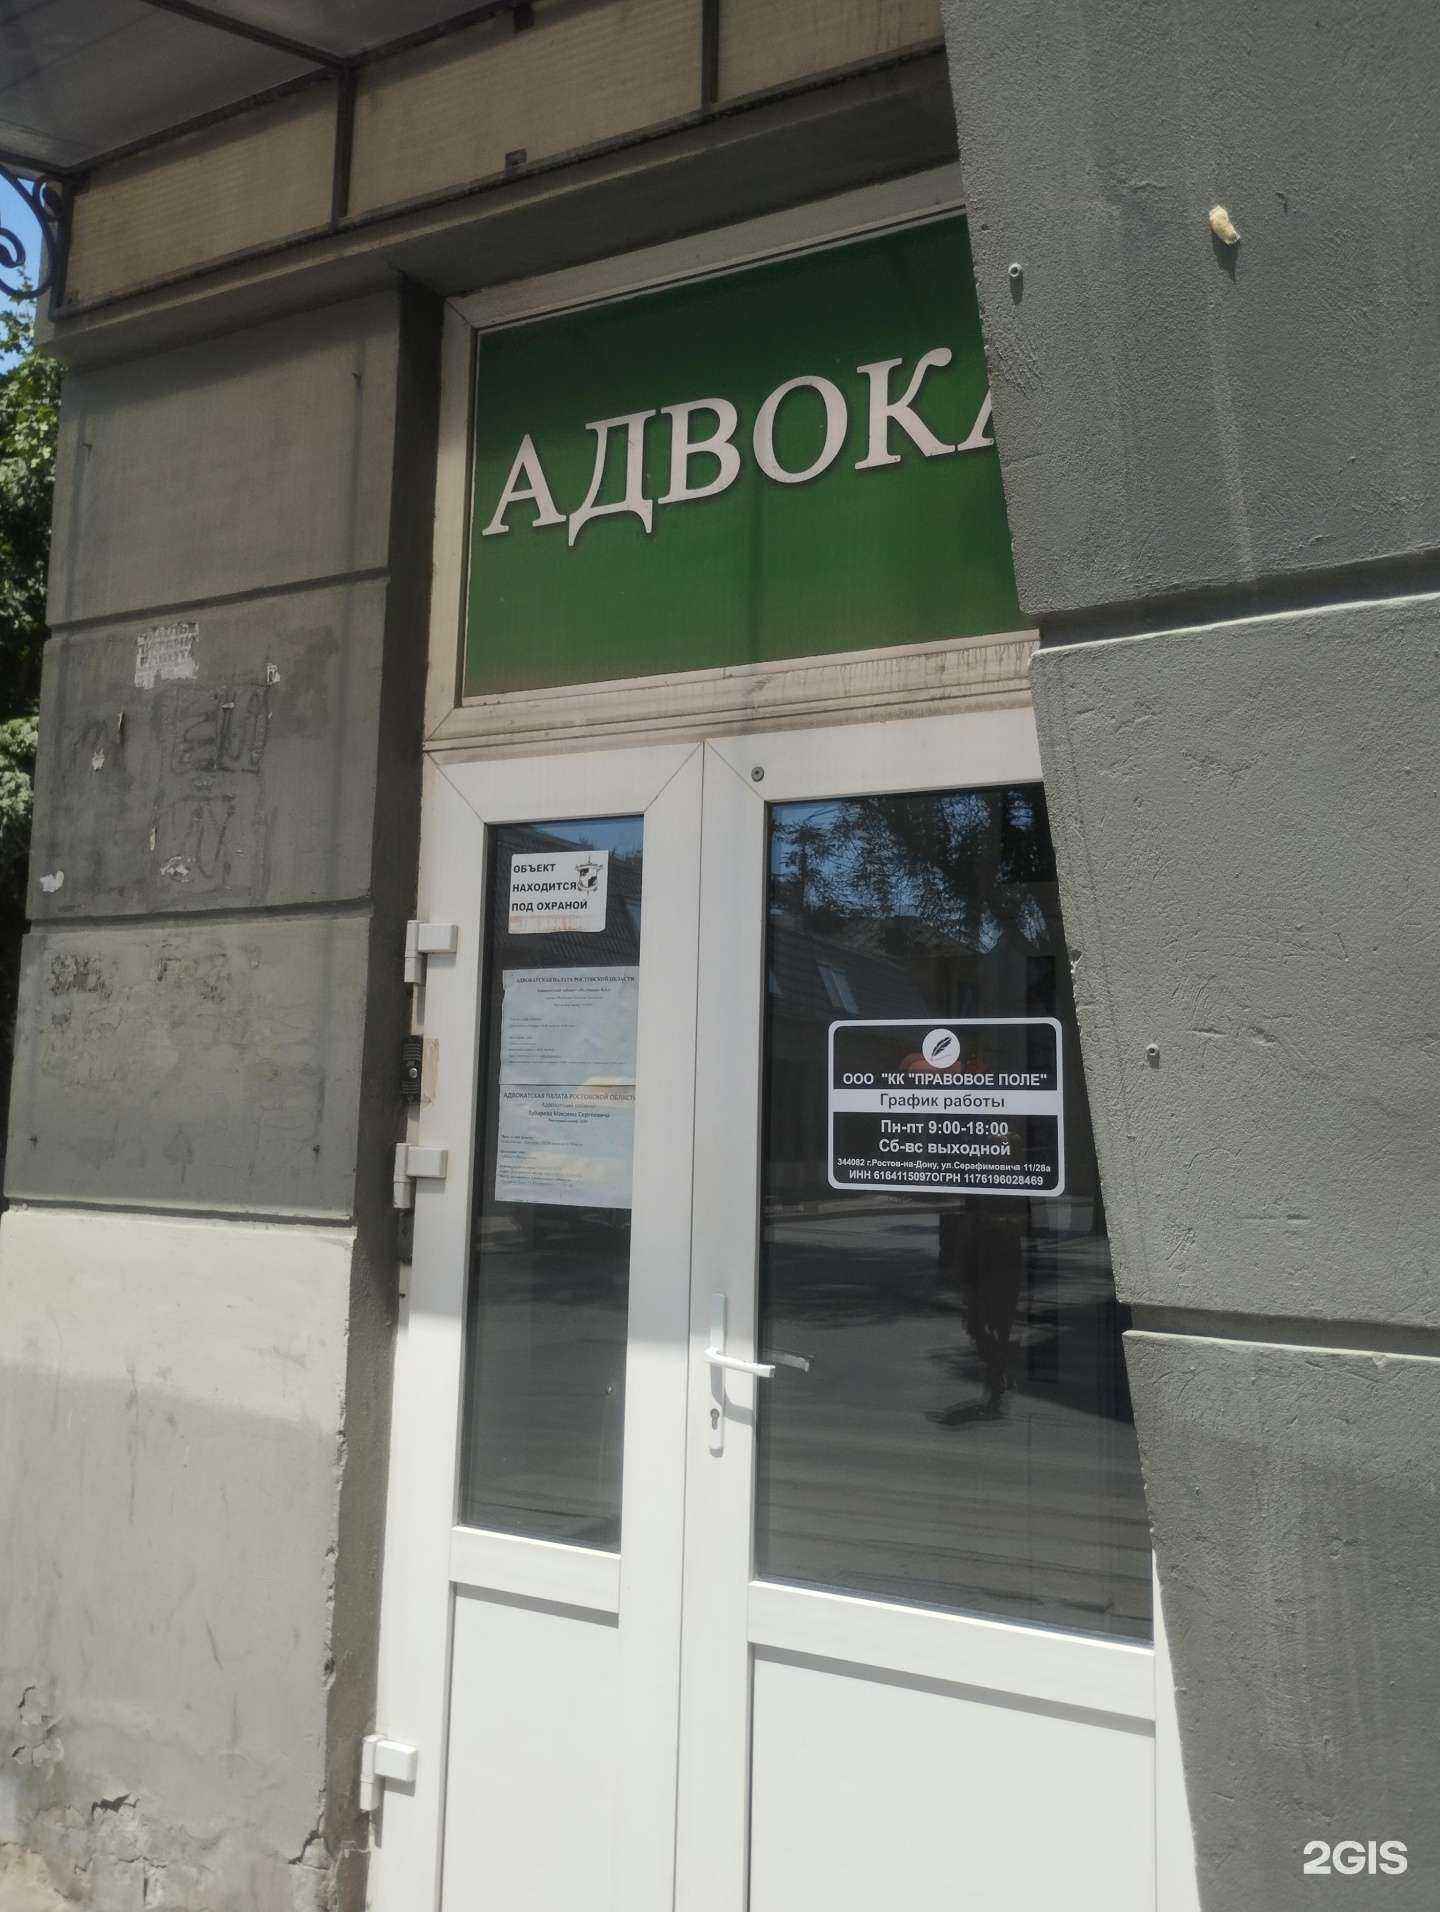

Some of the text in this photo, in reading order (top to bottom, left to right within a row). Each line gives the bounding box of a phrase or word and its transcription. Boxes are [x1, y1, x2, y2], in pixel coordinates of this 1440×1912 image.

[513, 863, 556, 874] ОБЪЕКТ
[512, 881, 577, 893] НАХОДИТСЯ
[511, 900, 588, 913] ПОД ОХРАНОЙ
[843, 1072, 1048, 1086] ООО "КК "ПРАВОВОЕ ПОЛЕ"
[880, 1093, 1005, 1110] График работы
[881, 1119, 1009, 1136] Пн-пт 9:00-18:00
[879, 1138, 1011, 1157] Сб-вс выходной
[849, 1169, 871, 1180] ИНН
